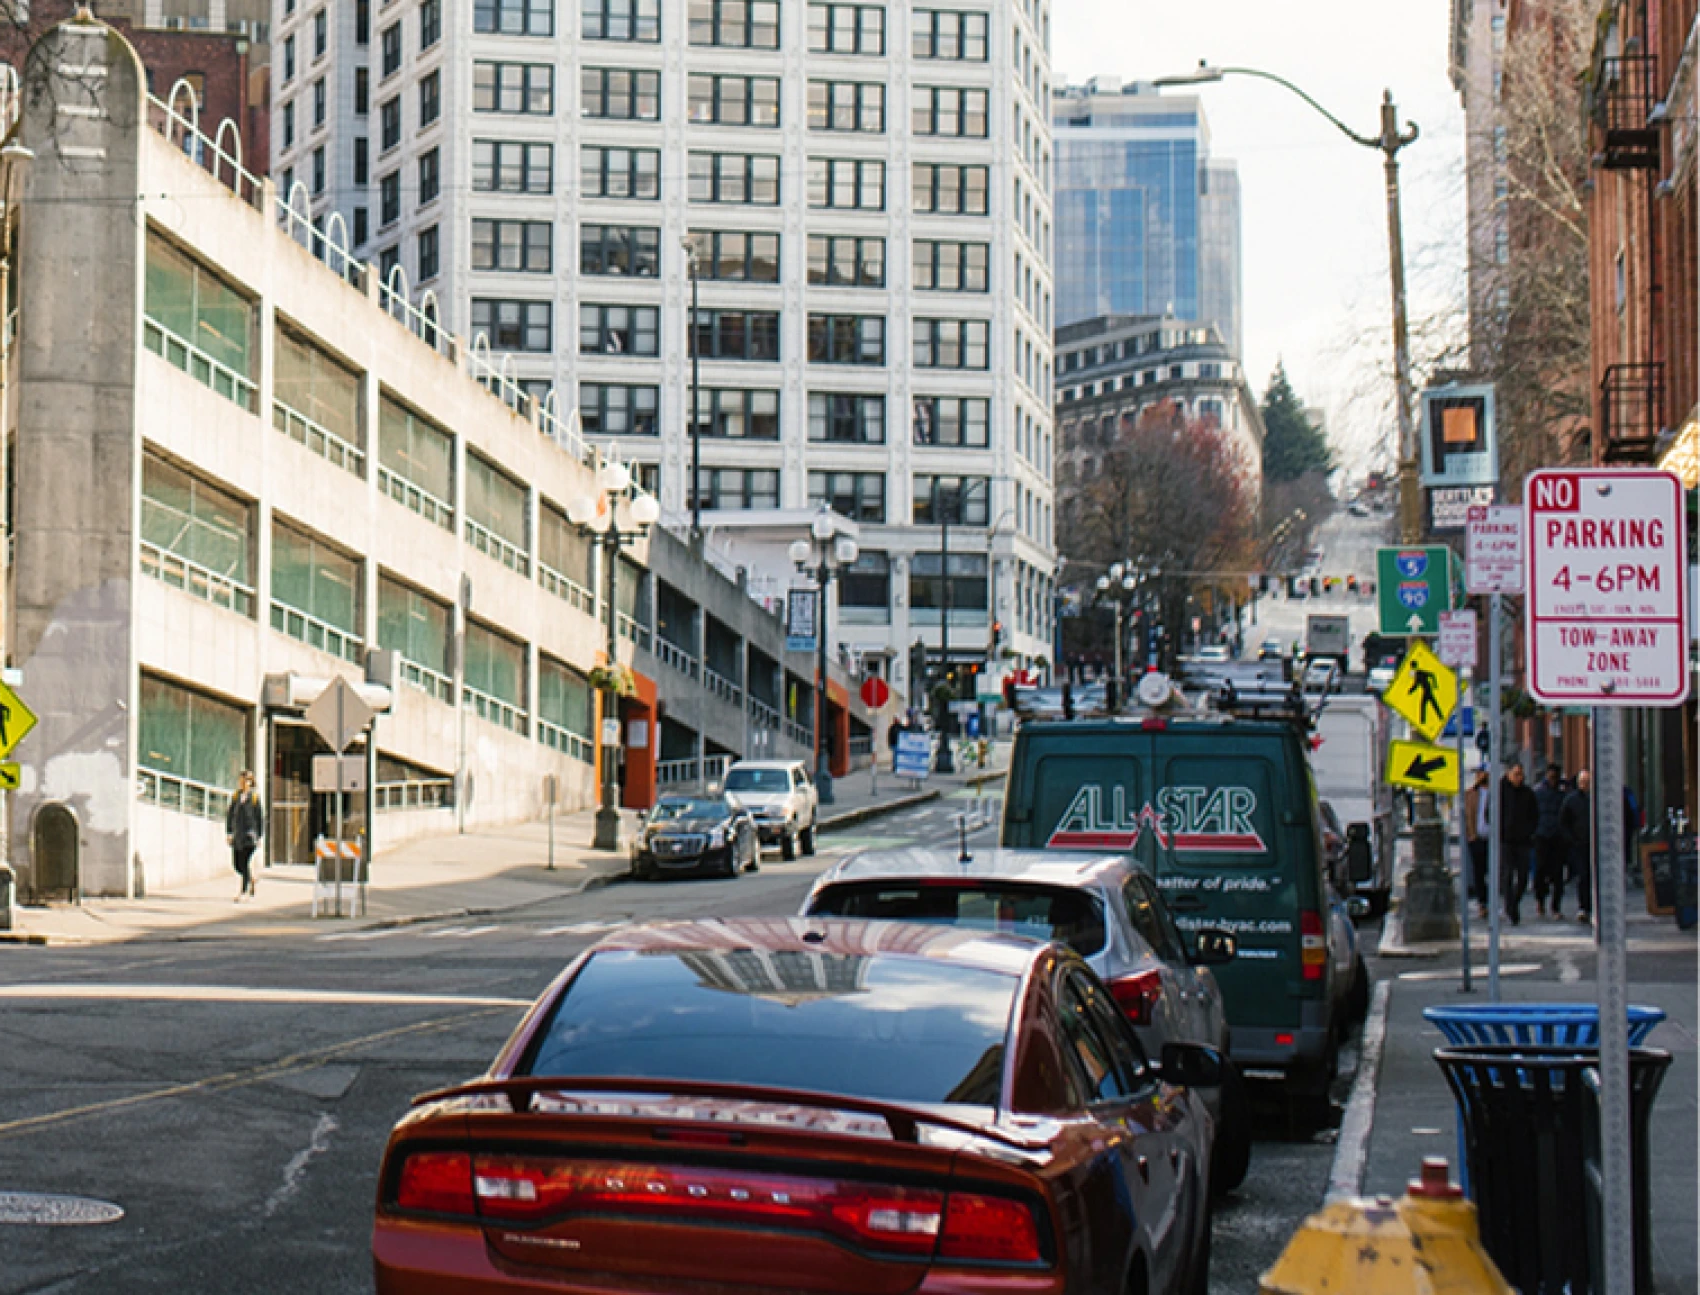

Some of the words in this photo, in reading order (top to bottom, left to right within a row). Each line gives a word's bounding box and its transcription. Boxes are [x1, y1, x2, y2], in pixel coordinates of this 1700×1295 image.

[1536, 478, 1573, 508] NO
[1473, 523, 1518, 534] PARKING
[1546, 518, 1665, 548] PARKING
[1407, 561, 1419, 576] 5
[1551, 564, 1661, 593] 4-6PM
[1402, 591, 1426, 607] 90
[1559, 627, 1659, 647] TOW-AWAY
[1587, 652, 1631, 672] ZONE
[1056, 784, 1139, 832] ALL
[1157, 786, 1257, 834] STAR
[1202, 876, 1222, 890] of
